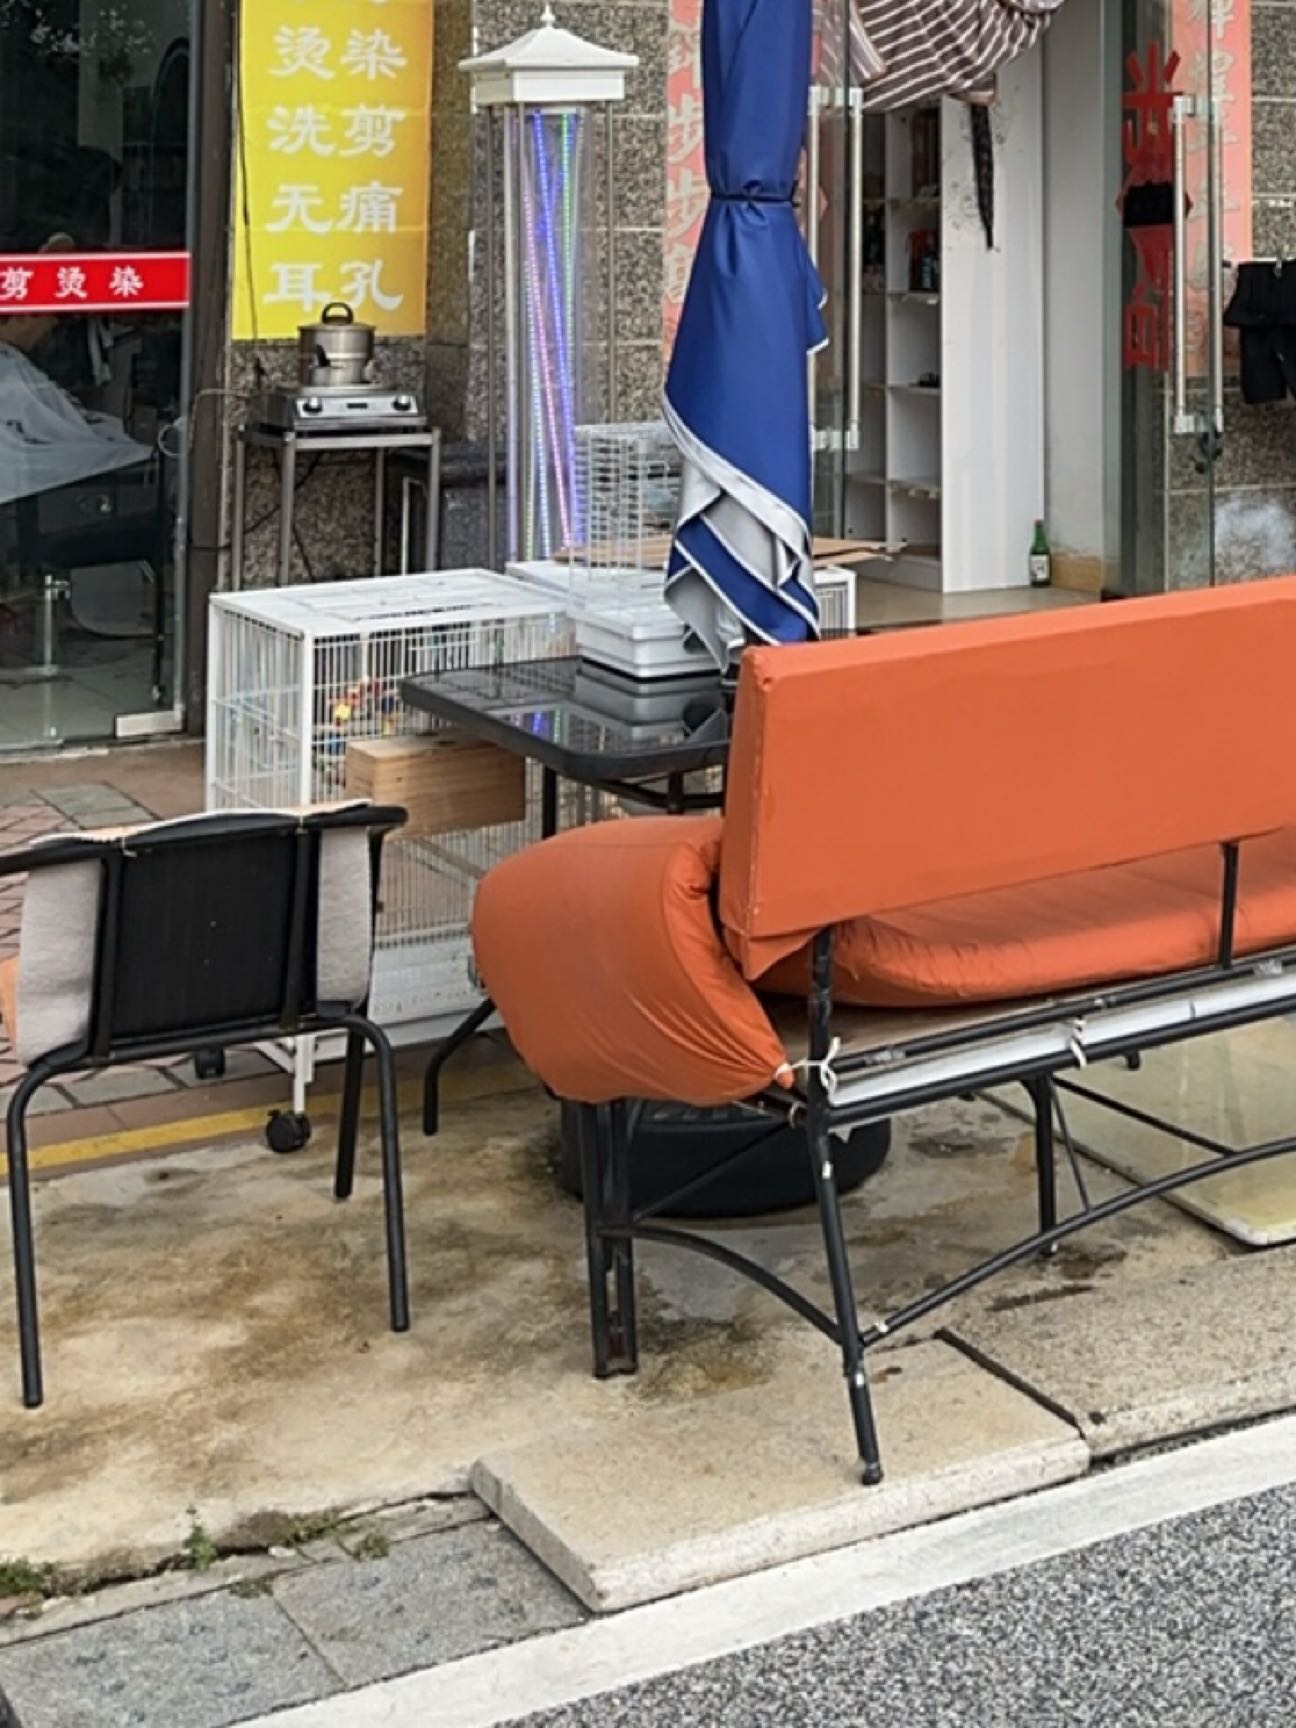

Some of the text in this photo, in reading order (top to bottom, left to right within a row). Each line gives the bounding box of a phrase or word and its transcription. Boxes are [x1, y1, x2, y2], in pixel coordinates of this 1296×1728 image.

[269, 25, 408, 81] 烫染
[266, 104, 408, 159] 洗剪
[270, 182, 403, 234] 无痛
[264, 260, 405, 312] 耳孔
